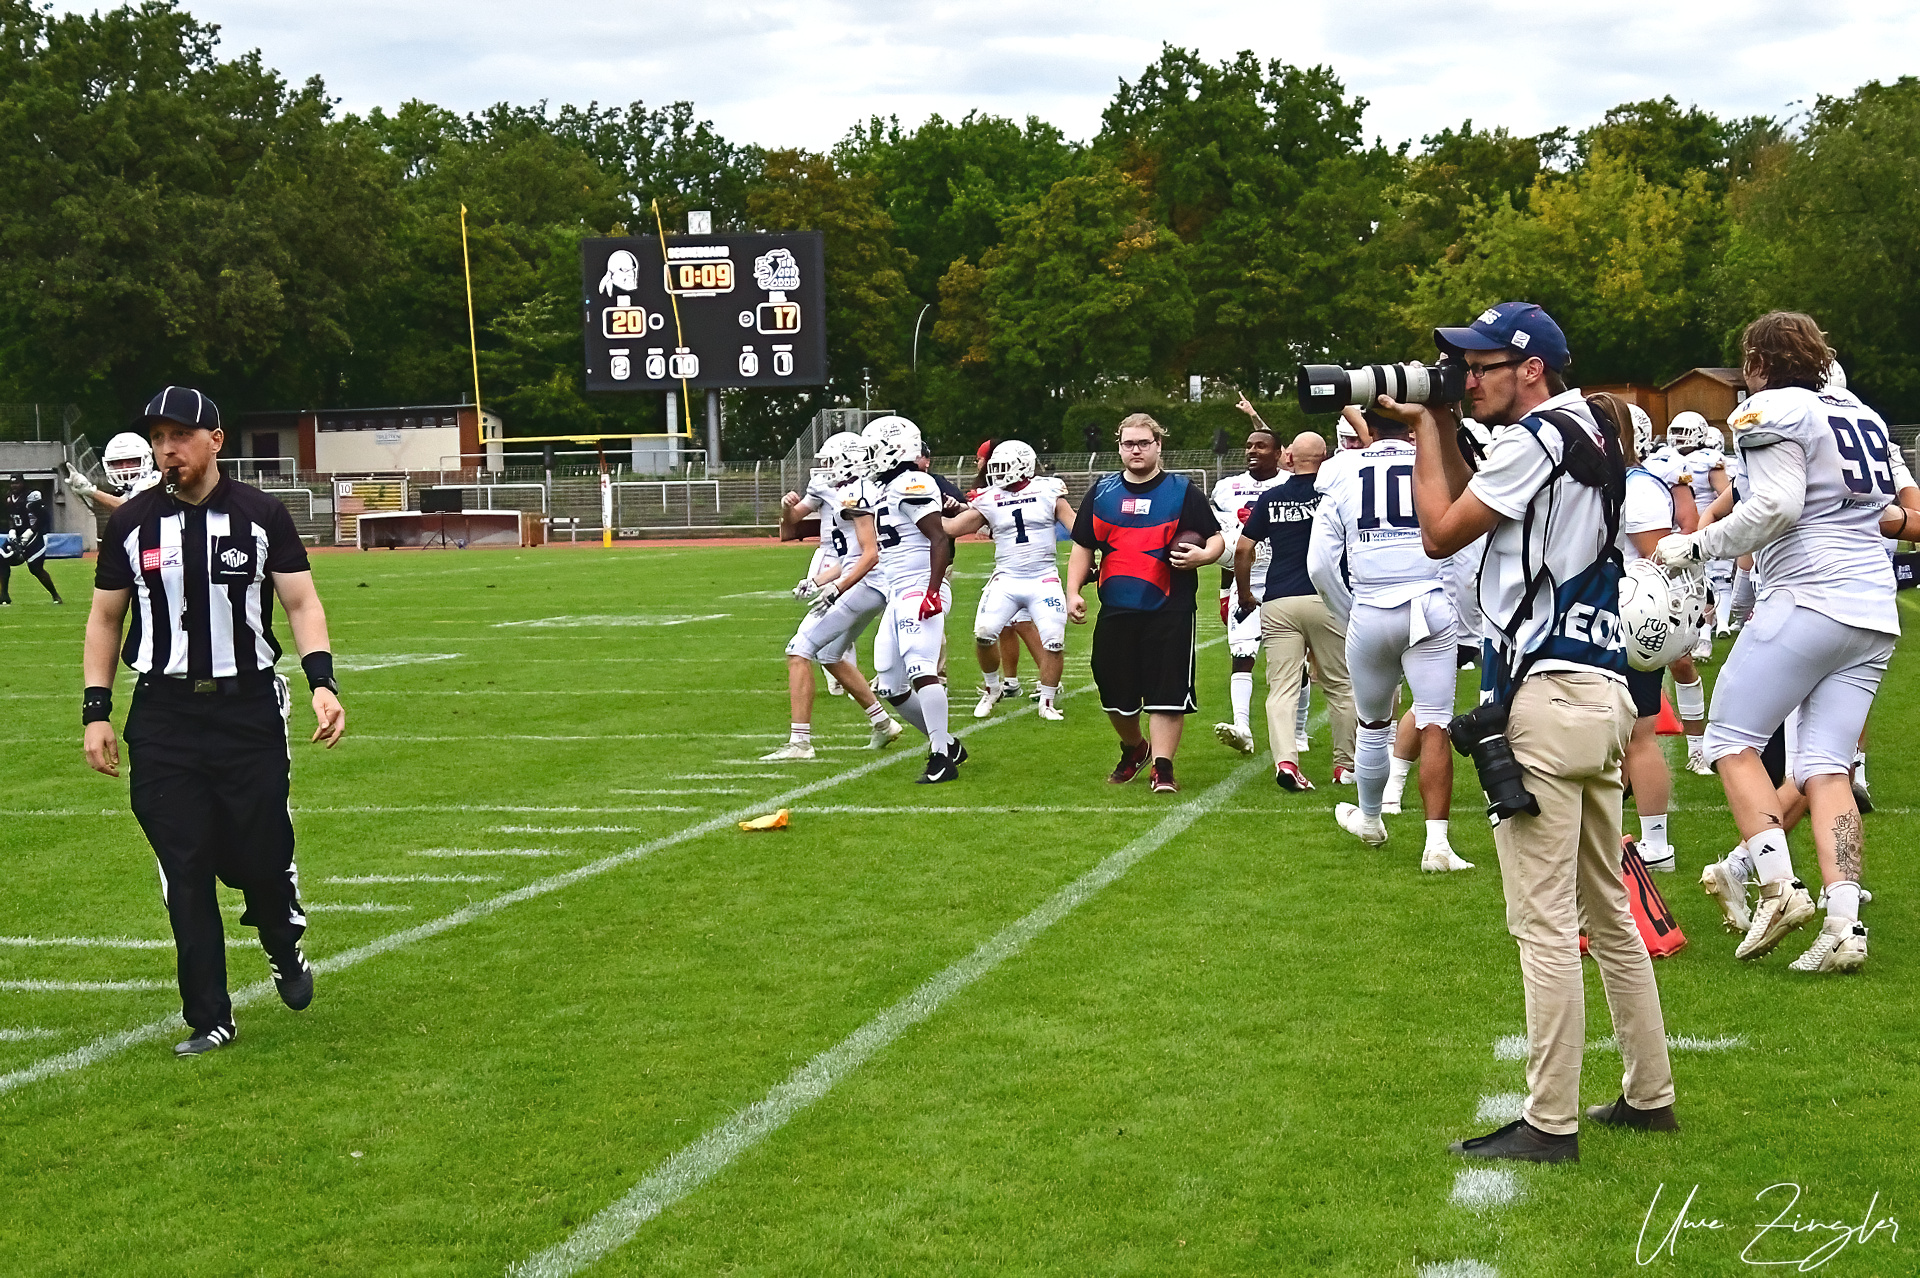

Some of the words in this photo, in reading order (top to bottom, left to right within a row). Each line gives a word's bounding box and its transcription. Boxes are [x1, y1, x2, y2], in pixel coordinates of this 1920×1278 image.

[680, 264, 730, 288] 0:09
[612, 311, 642, 333] 20
[774, 307, 796, 329] 17
[1363, 449, 1416, 457] NAPOLEON
[1828, 415, 1896, 494] 99
[341, 484, 351, 494] 10
[1357, 465, 1420, 530] 10
[1012, 508, 1029, 544] 1
